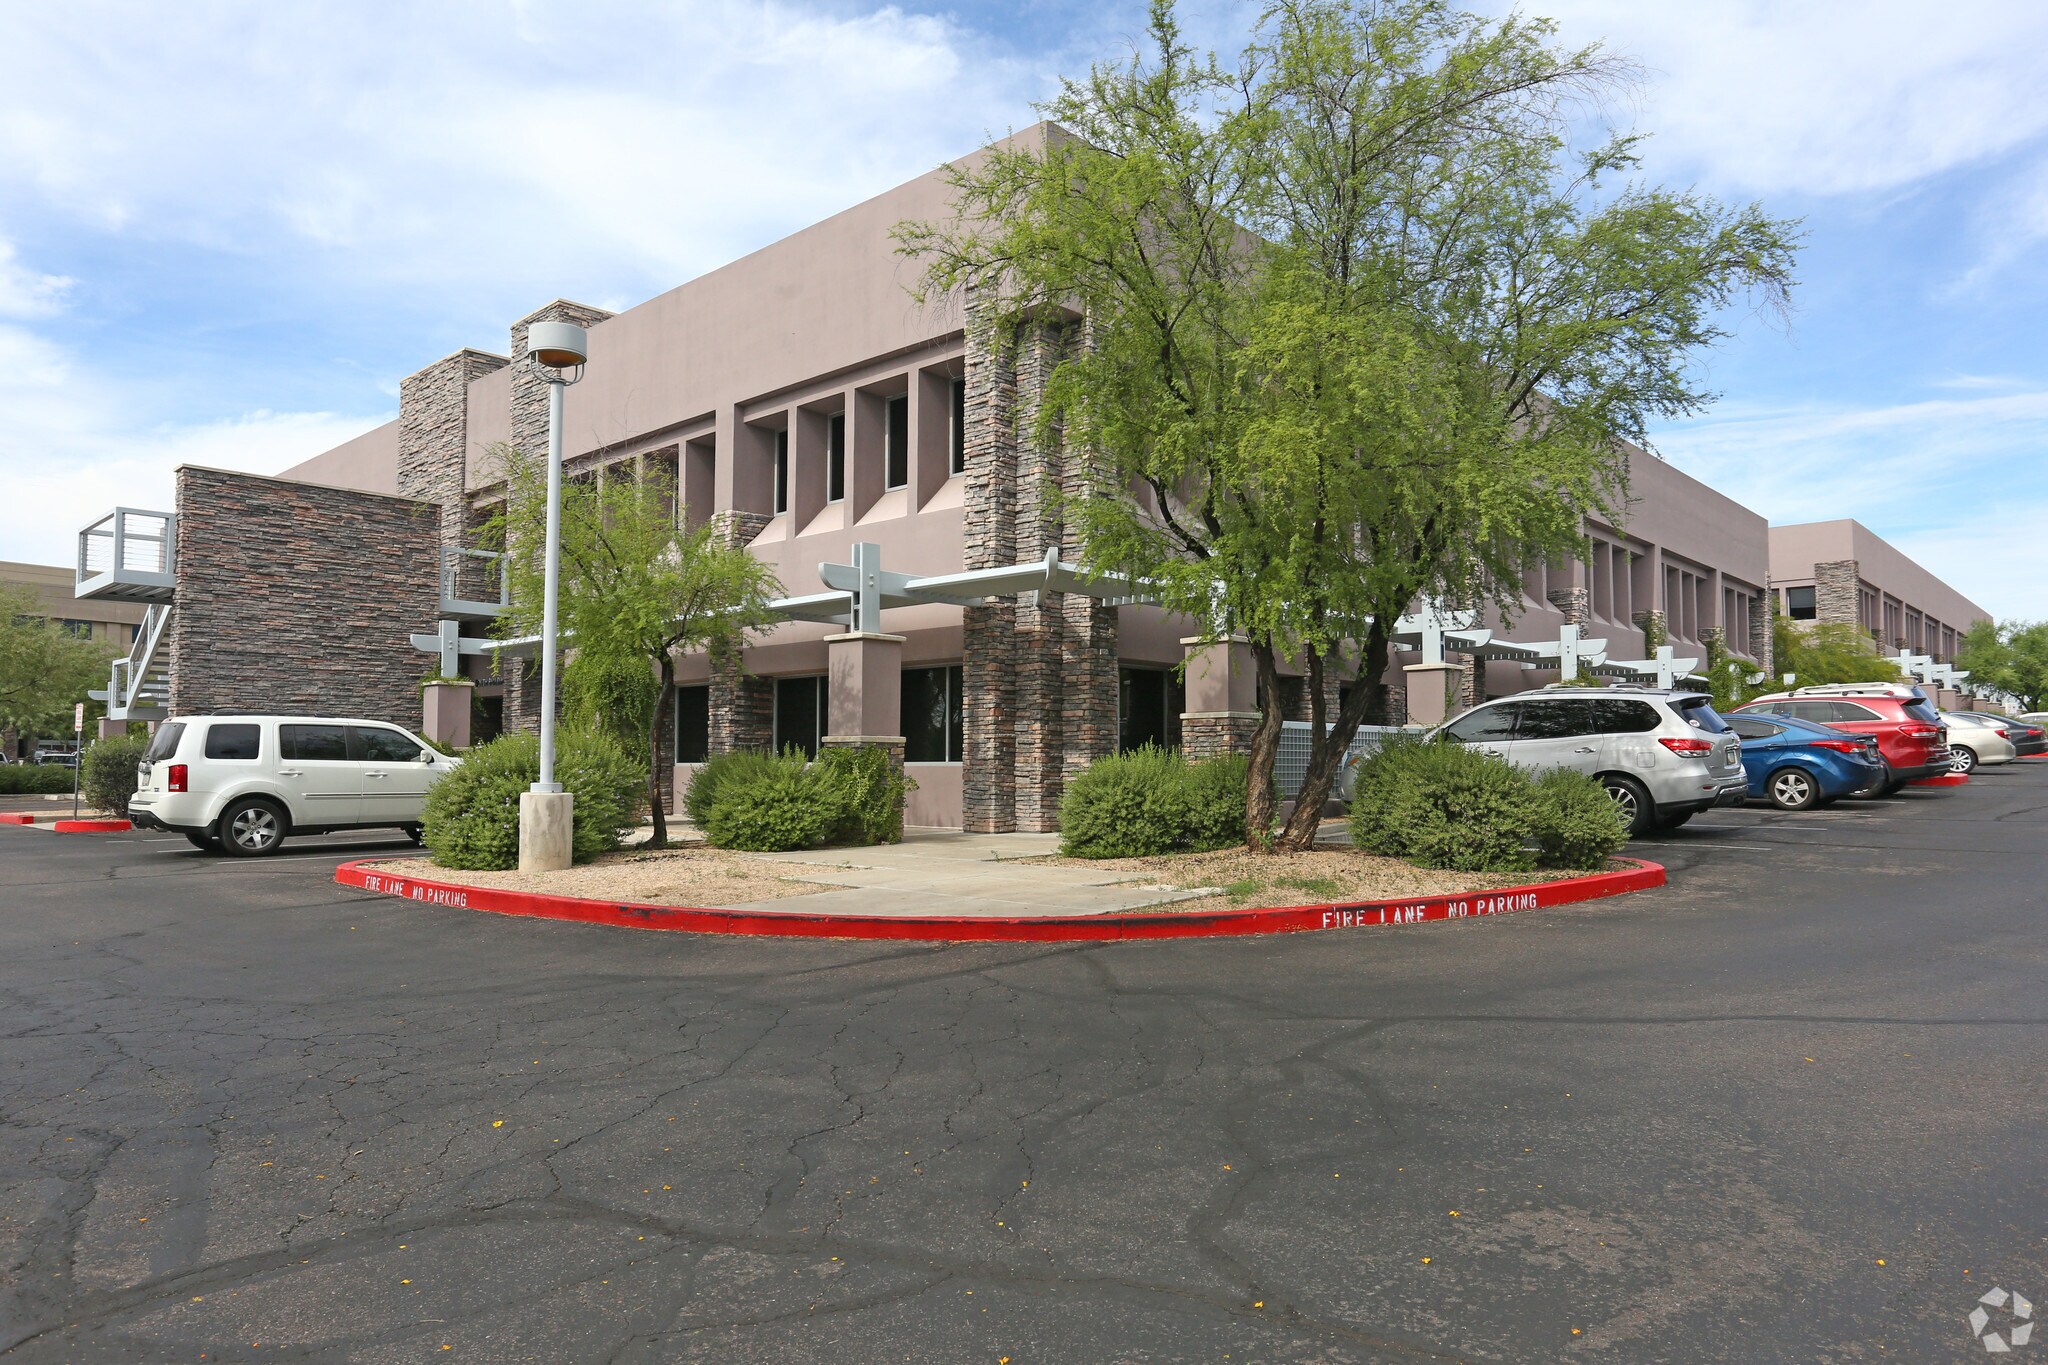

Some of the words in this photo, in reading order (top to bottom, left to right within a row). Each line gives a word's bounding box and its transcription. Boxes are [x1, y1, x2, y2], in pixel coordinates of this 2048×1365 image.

[365, 876, 381, 891] FIRE
[384, 880, 404, 896] LANE
[412, 886, 424, 900] NO
[427, 888, 467, 907] PARKING
[1322, 909, 1366, 928] FIRE
[1448, 902, 1468, 918] NO
[1477, 893, 1537, 915] PARKING
